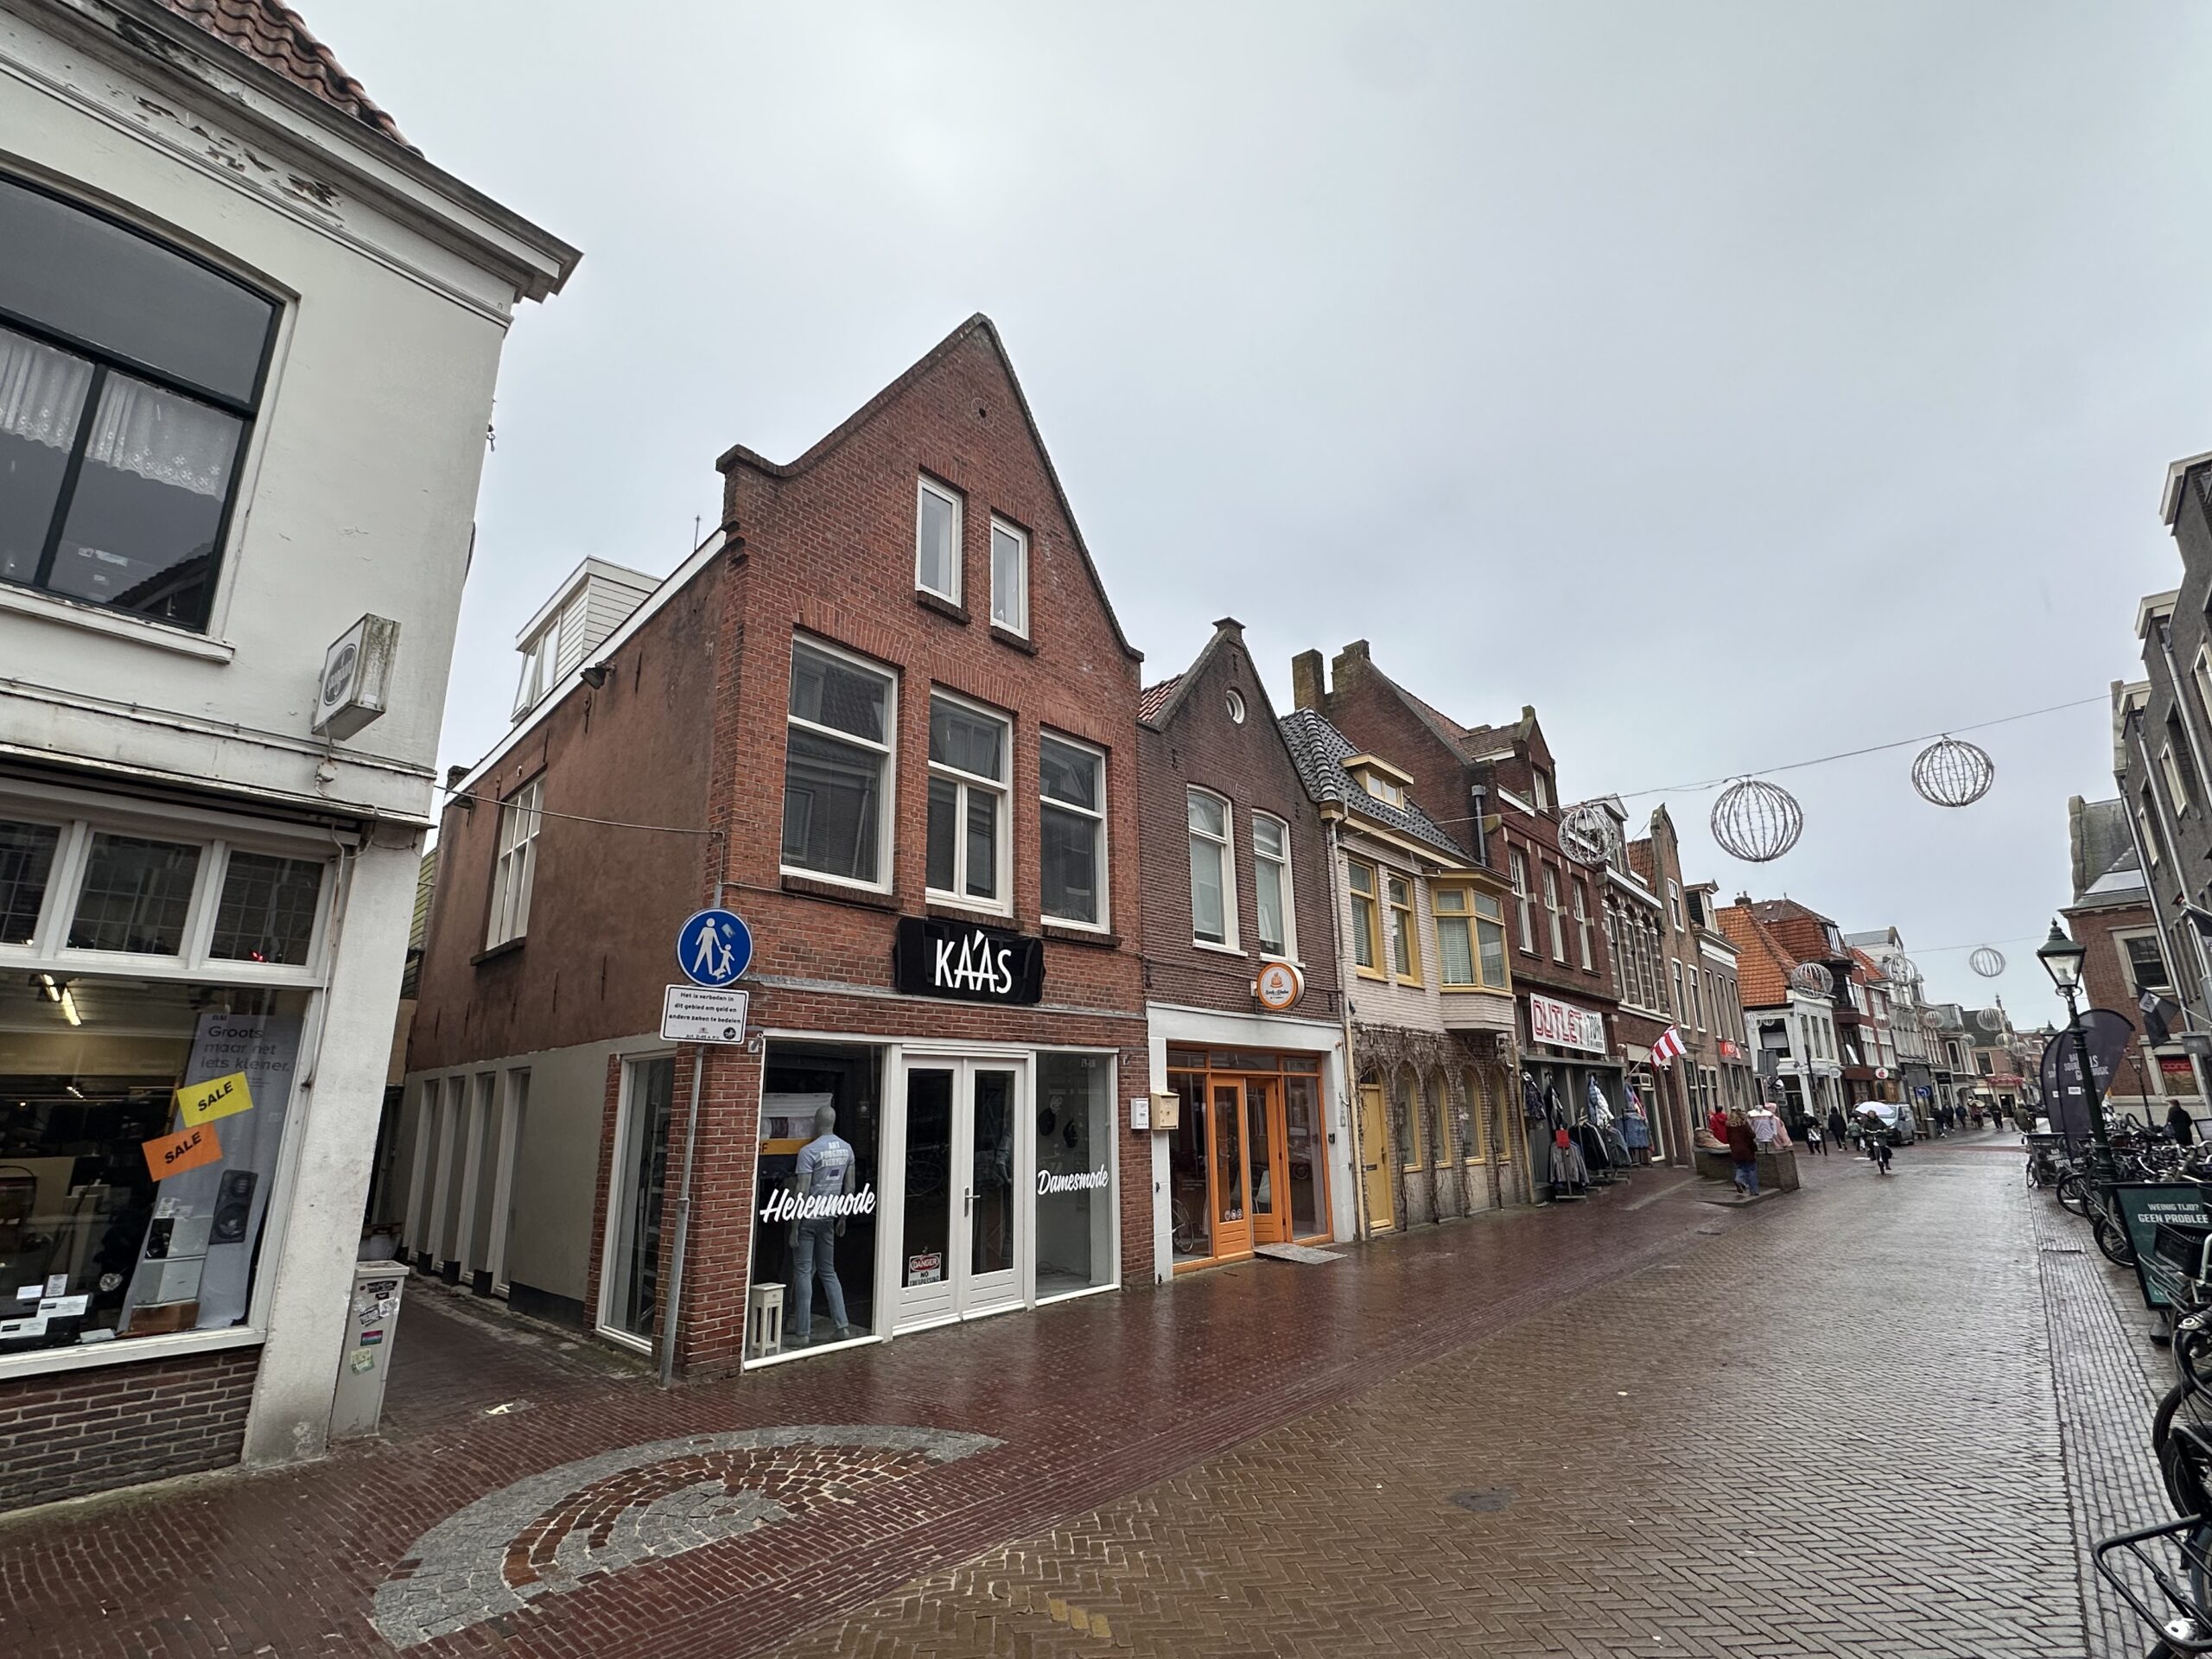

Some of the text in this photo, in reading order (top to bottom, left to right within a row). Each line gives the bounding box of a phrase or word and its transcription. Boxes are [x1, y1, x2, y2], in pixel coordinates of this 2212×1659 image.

[1534, 1000, 1583, 1045] OUTLET
[208, 1025, 264, 1039] Groots
[204, 1042, 278, 1056] maar net
[200, 1056, 291, 1073] iets kleiner.
[198, 1081, 233, 1111] SALE
[164, 1131, 201, 1164] SALE
[1037, 1163, 1109, 1196] Damesmode
[760, 1182, 877, 1224] Herenmode
[2147, 1203, 2200, 1211] WEINIG TIJD?
[2137, 1213, 2163, 1224] GEEN
[912, 1258, 938, 1268] DANGER
